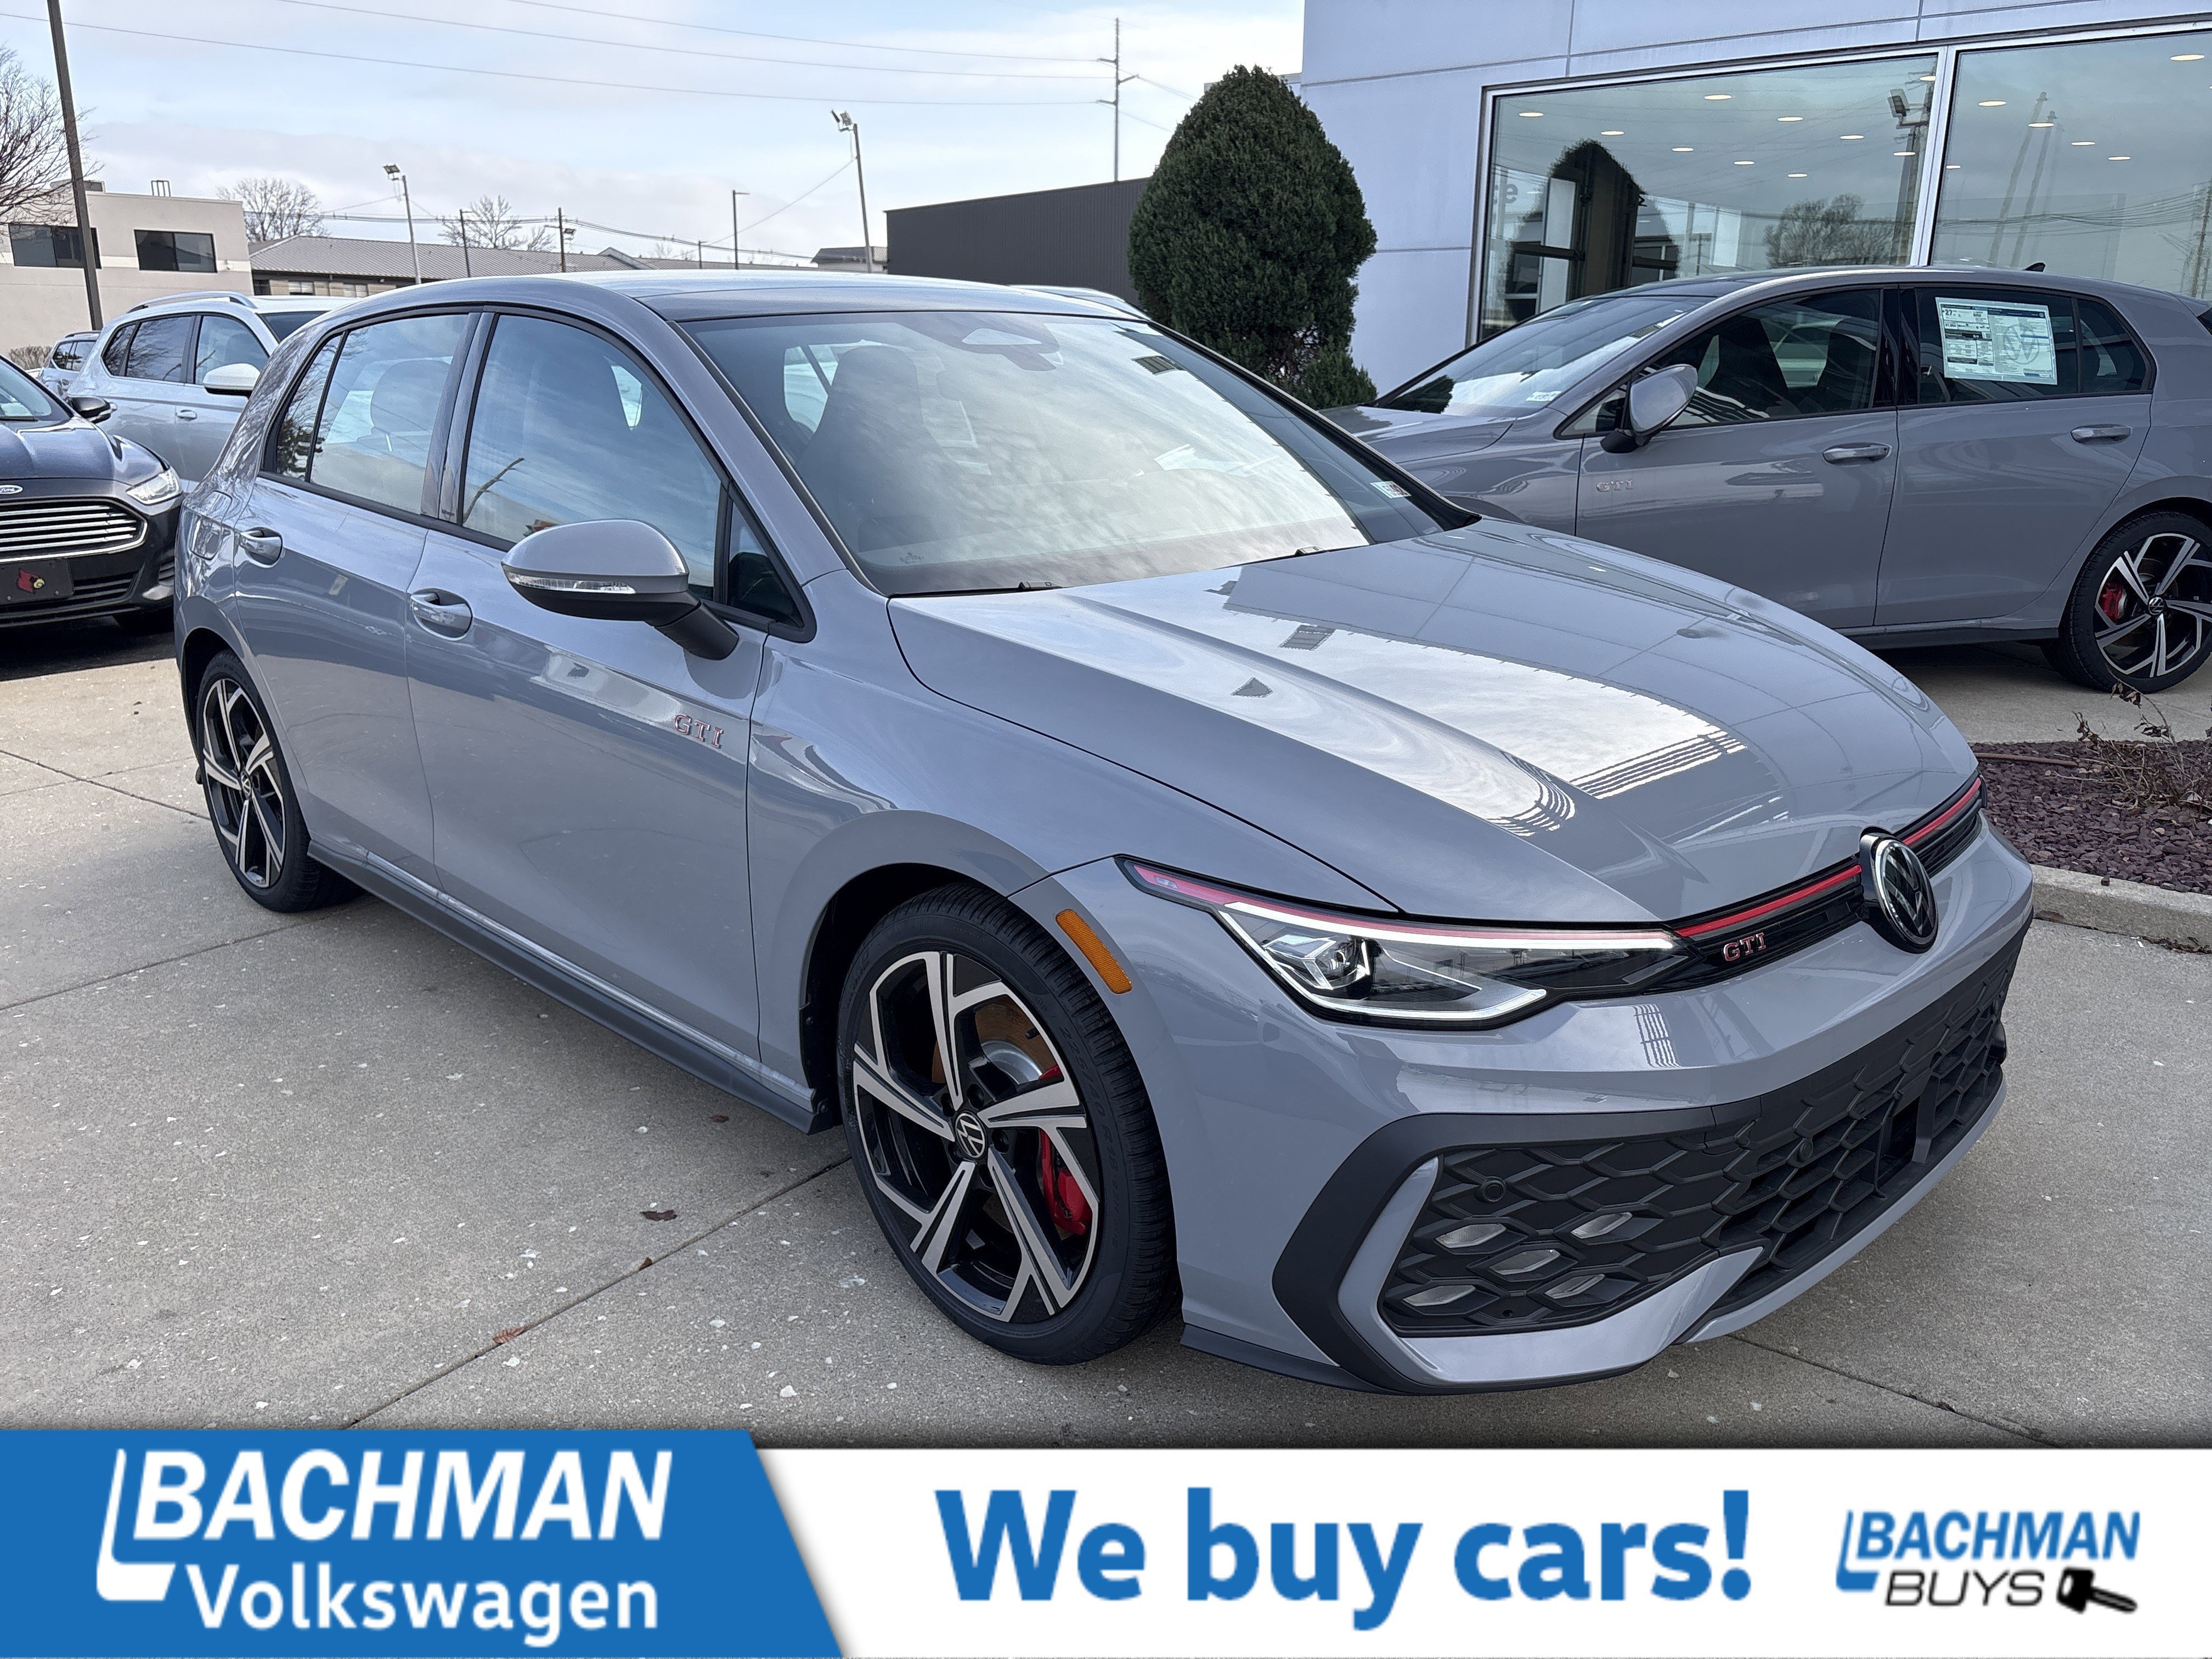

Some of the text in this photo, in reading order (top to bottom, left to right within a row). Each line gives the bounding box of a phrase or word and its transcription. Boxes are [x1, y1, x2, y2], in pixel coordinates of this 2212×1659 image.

[1596, 479, 1633, 492] GTI
[674, 713, 724, 749] GTI
[1723, 932, 1767, 961] GTI
[1101, 1124, 1119, 1172] R18
